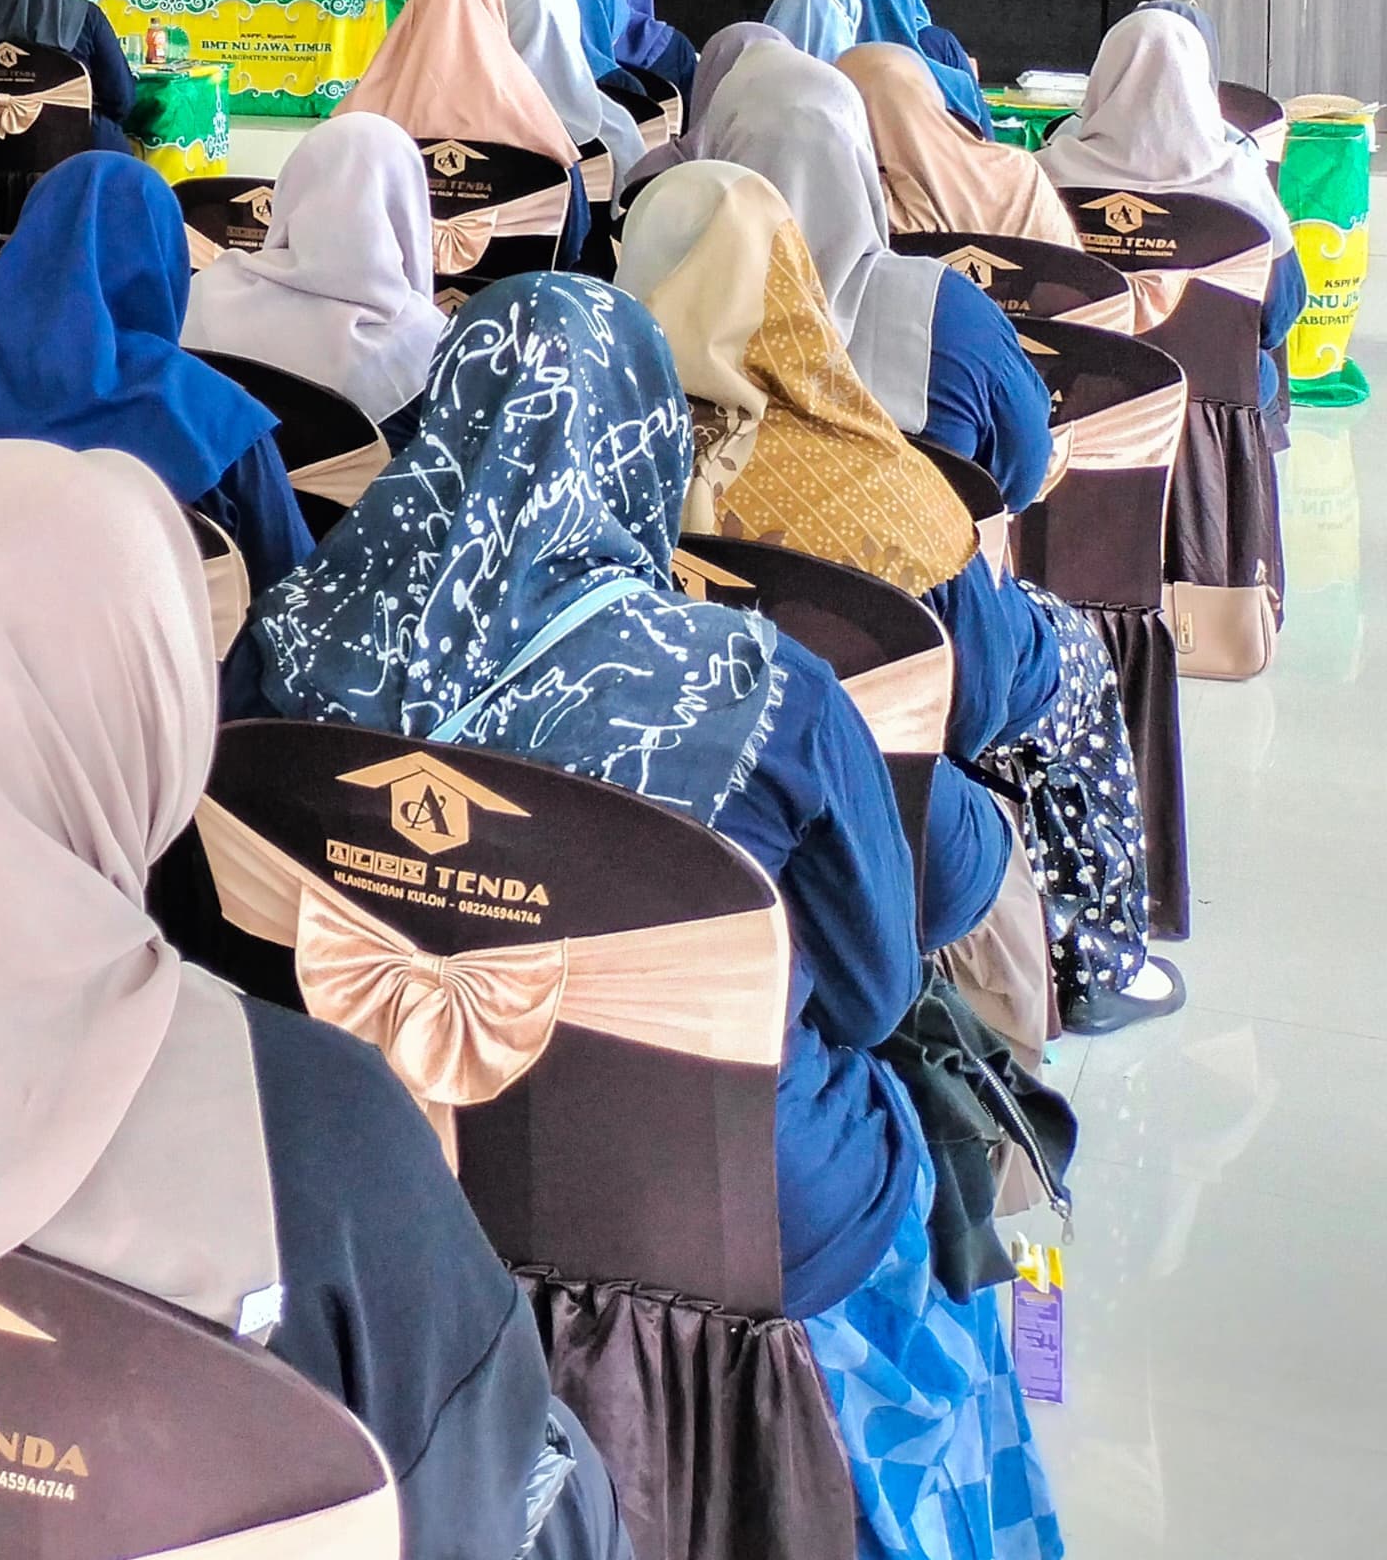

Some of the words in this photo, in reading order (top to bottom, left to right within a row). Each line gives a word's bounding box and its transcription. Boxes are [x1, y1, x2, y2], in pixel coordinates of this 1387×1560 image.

[201, 40, 228, 51] BMT
[232, 41, 251, 52] NU
[254, 42, 290, 53] JAWA
[294, 44, 333, 54] TIMUR
[450, 179, 494, 193] TENDA
[1125, 238, 1178, 250] TENDA
[996, 299, 1032, 312] NDA
[433, 866, 551, 907] TENDA
[406, 887, 447, 909] KULON
